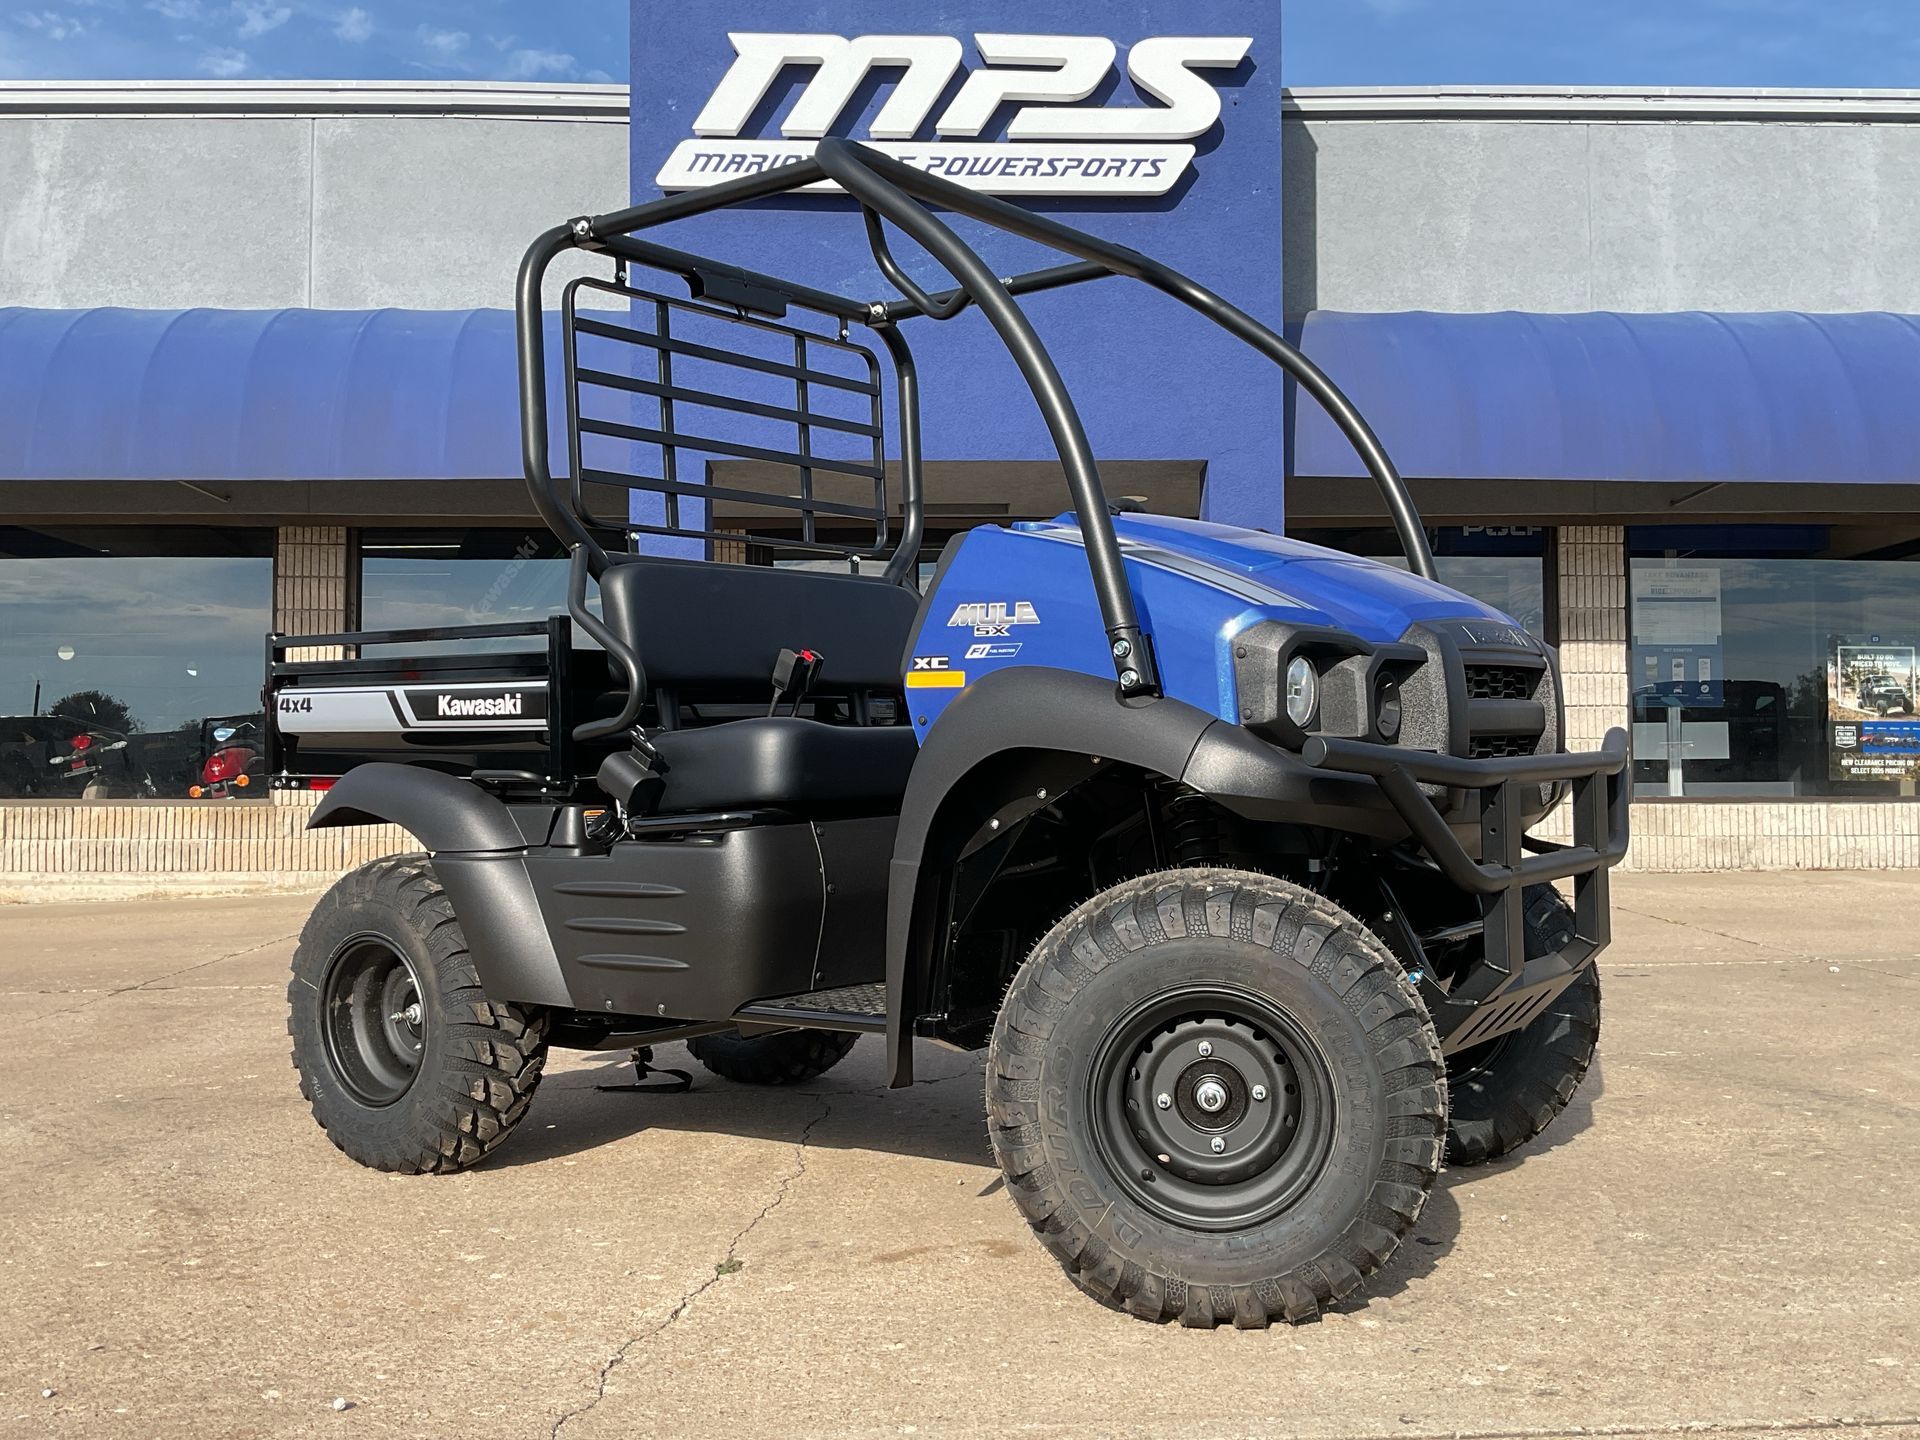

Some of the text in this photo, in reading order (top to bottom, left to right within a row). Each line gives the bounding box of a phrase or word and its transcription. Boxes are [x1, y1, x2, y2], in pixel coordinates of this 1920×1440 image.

[692, 33, 1253, 139] MPS
[925, 156, 1168, 178] POWERSPORTS
[947, 602, 1040, 626] MULE
[974, 625, 1010, 637] SX
[970, 647, 986, 656] FI
[914, 657, 949, 670] XC
[279, 697, 312, 713] 4x4
[437, 692, 522, 716] Kawasaki
